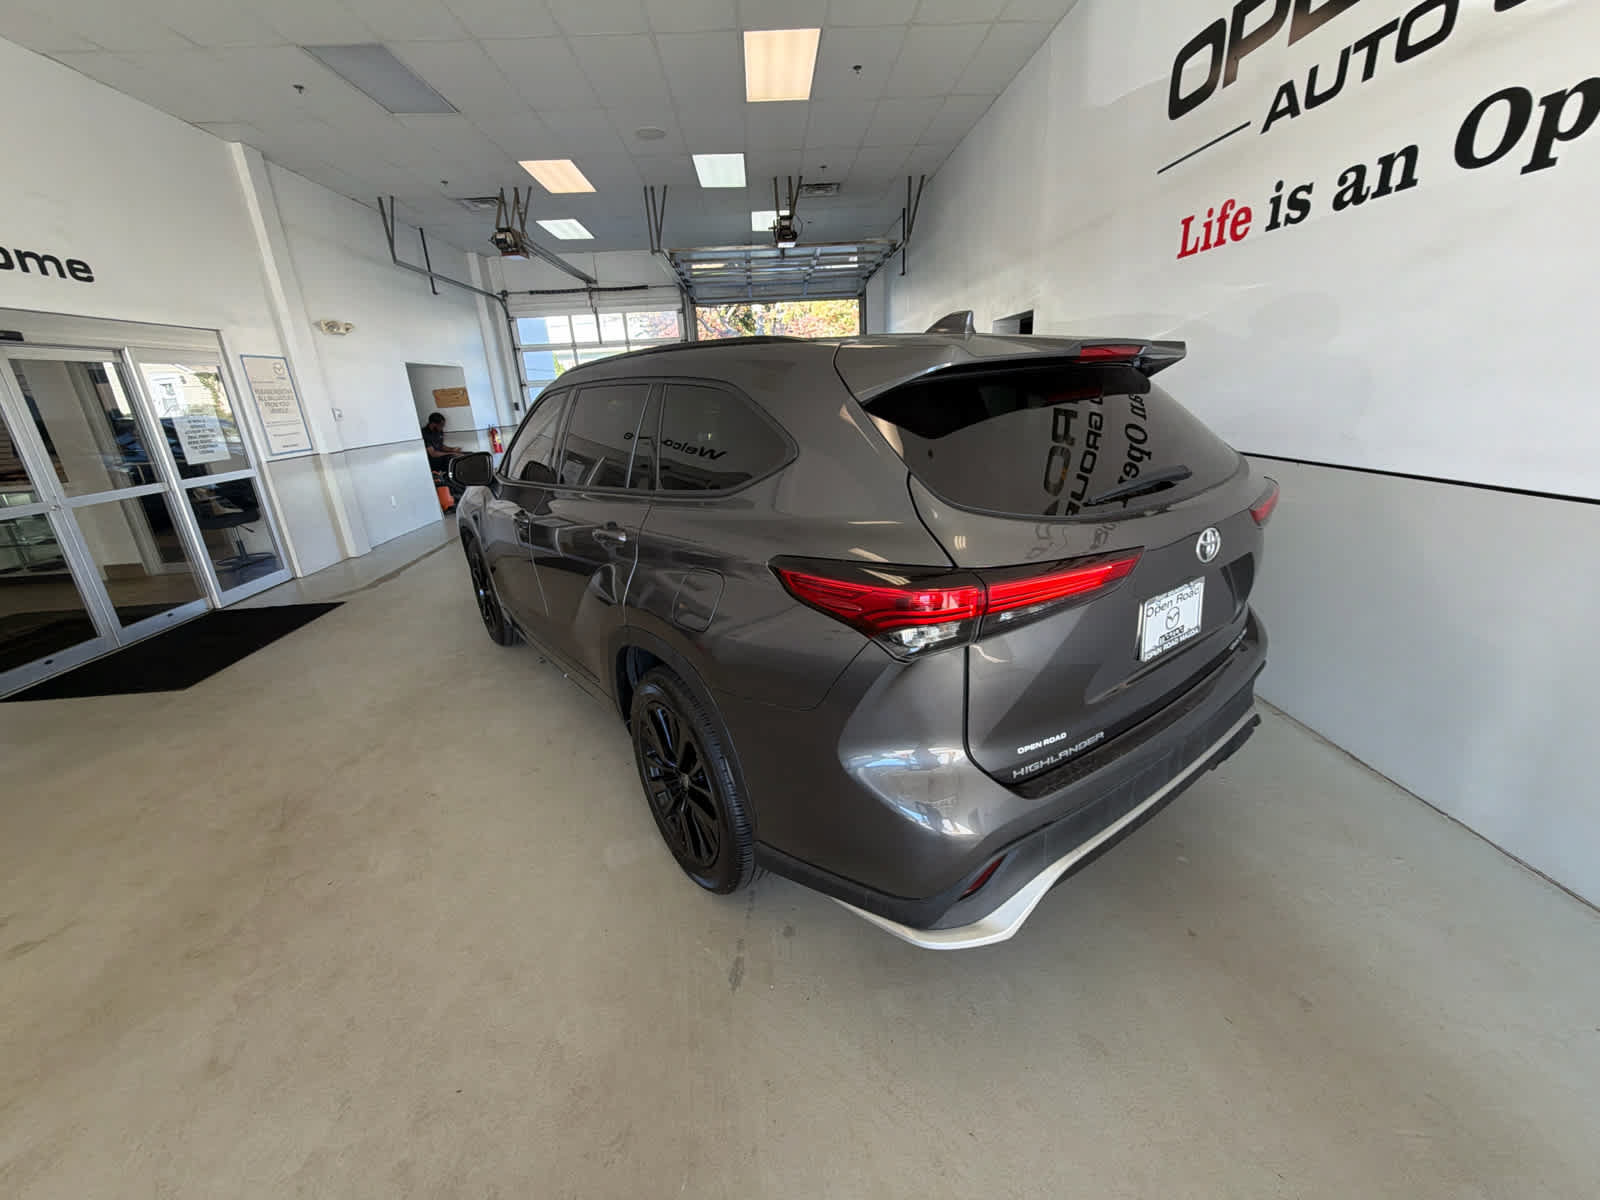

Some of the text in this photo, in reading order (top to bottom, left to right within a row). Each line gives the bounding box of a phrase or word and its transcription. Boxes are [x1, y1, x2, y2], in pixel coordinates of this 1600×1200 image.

[1260, 0, 1460, 134] AUTO
[1177, 198, 1252, 259] Life
[1265, 180, 1314, 232] is
[1332, 144, 1419, 211] an
[1146, 599, 1173, 617] Open
[1012, 731, 1105, 779] HIGHLANDER
[1017, 732, 1067, 754] OPEN ROAD
